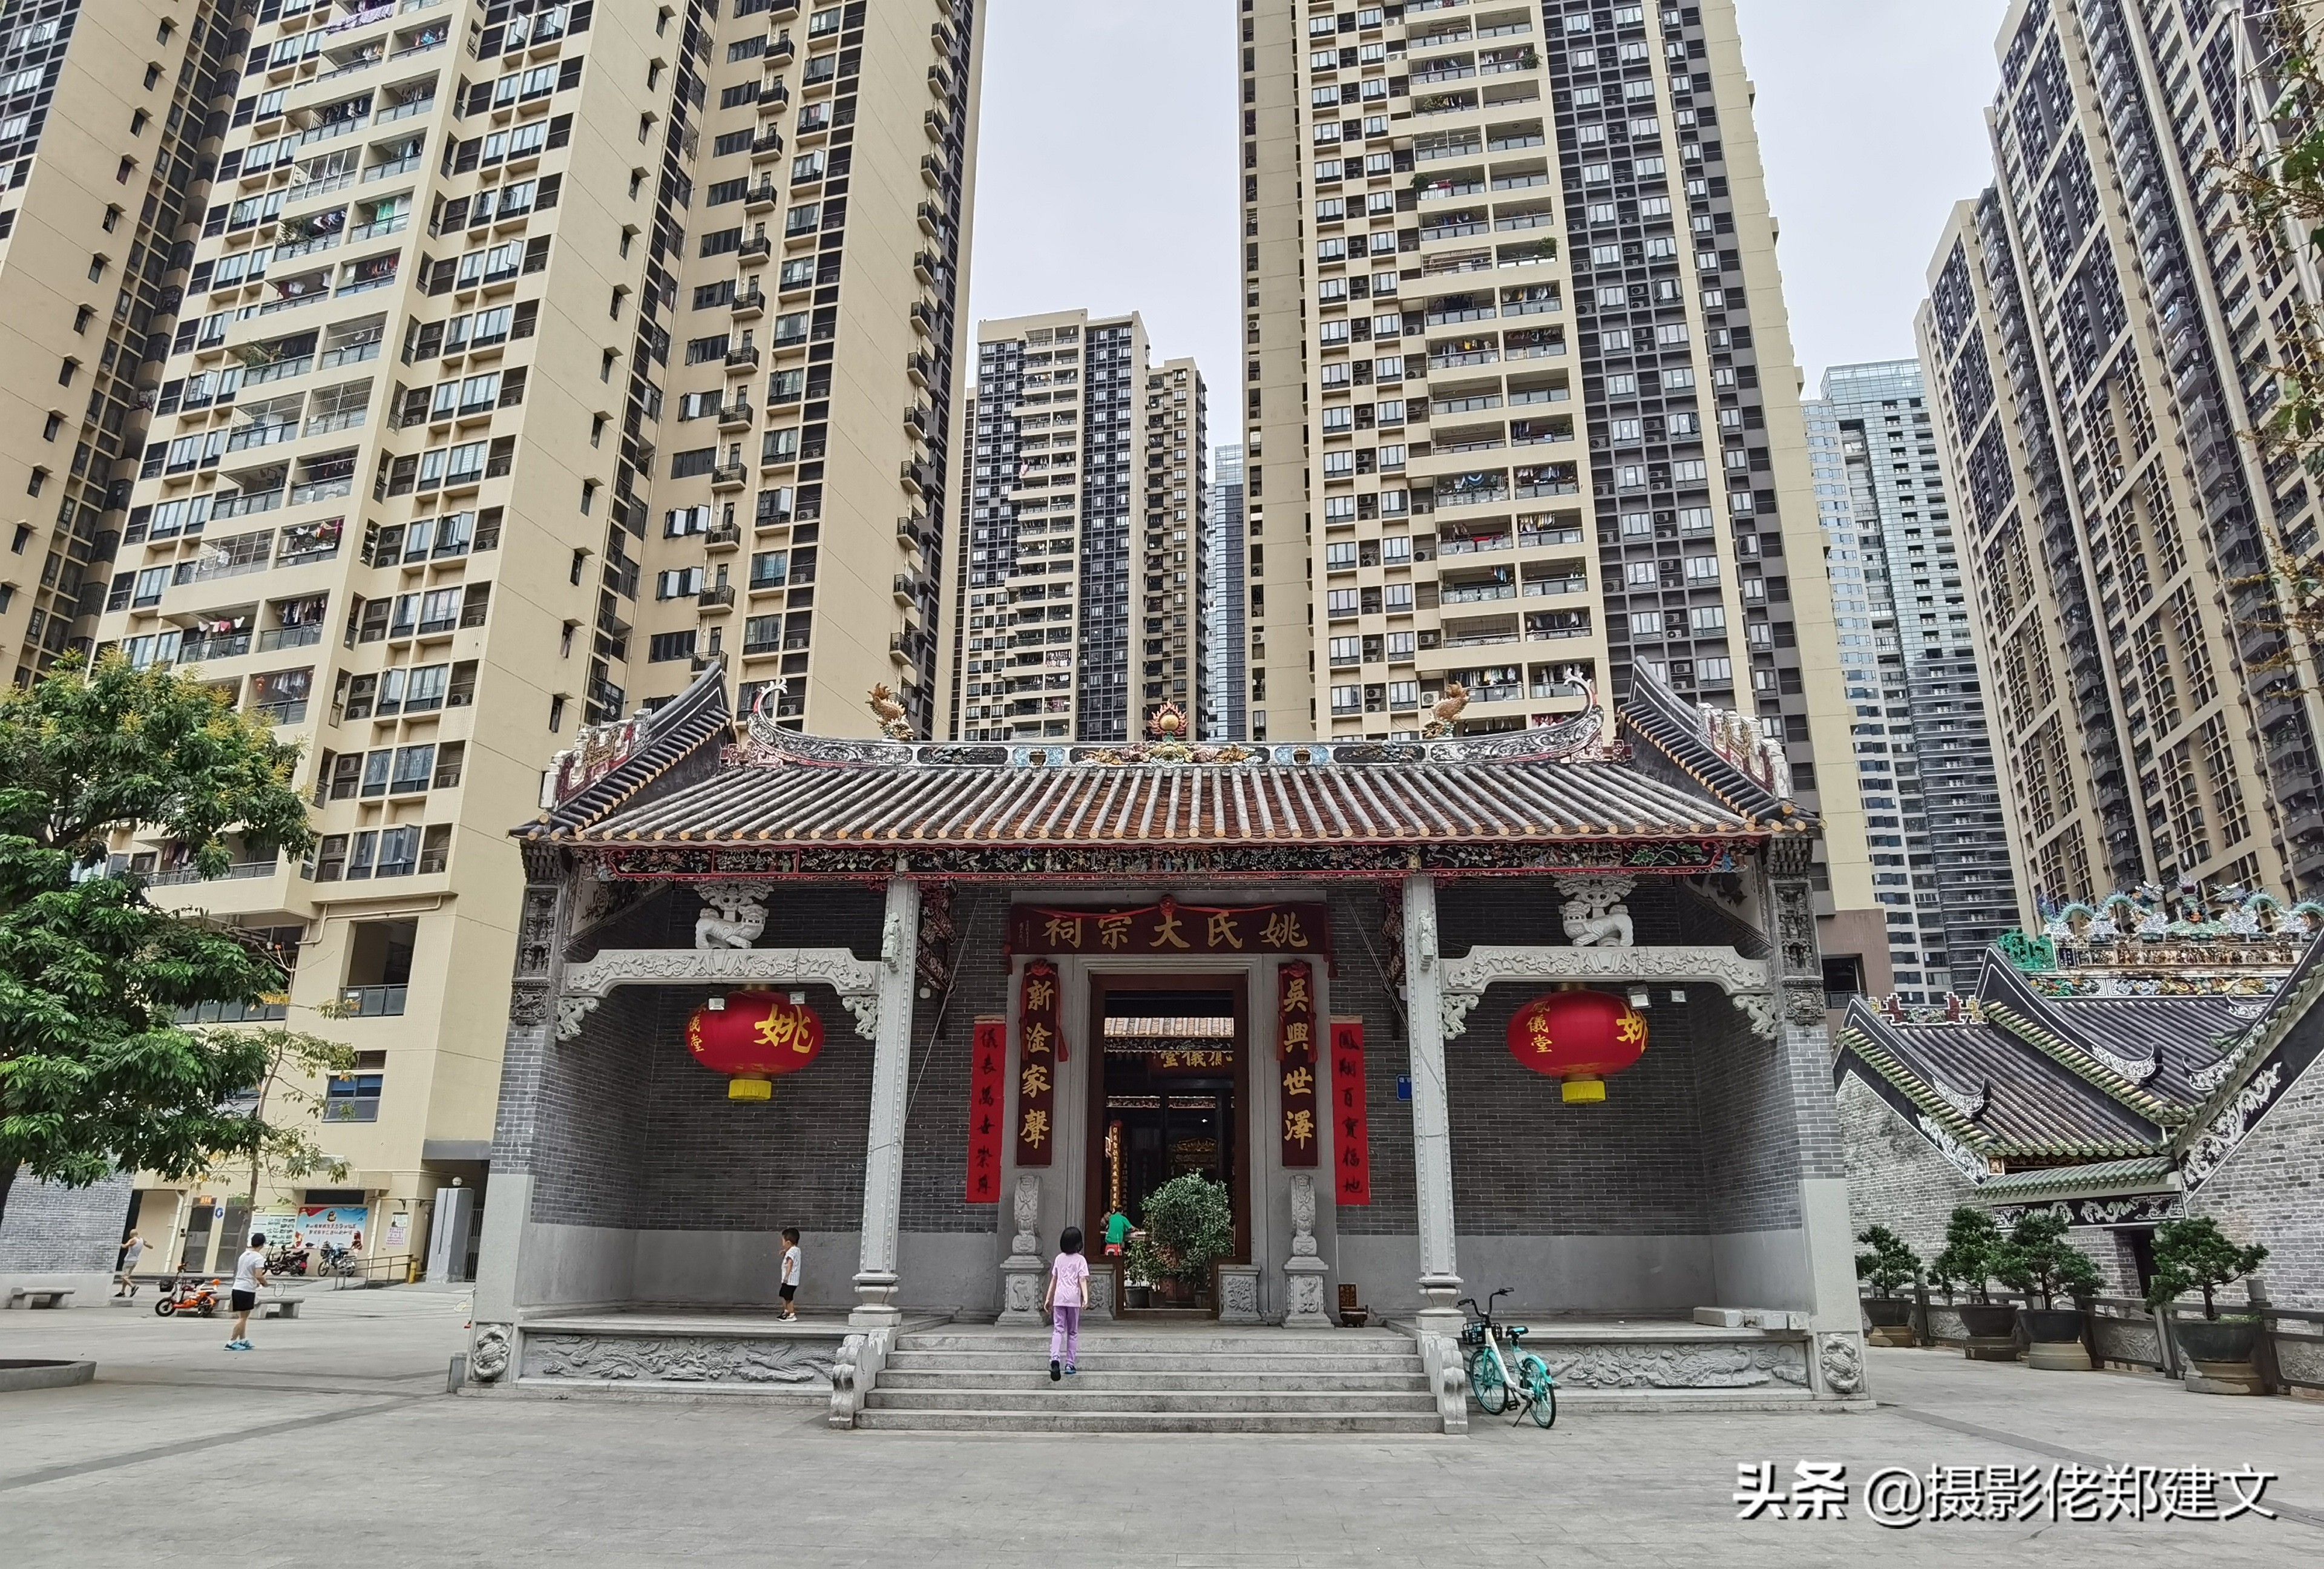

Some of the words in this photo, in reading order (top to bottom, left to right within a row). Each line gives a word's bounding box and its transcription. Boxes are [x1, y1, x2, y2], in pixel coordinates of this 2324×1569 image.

[1042, 909, 1308, 950] 姚氏大宗祠
[753, 1003, 814, 1053] 姚
[1020, 979, 1055, 1150] 新淦家聲
